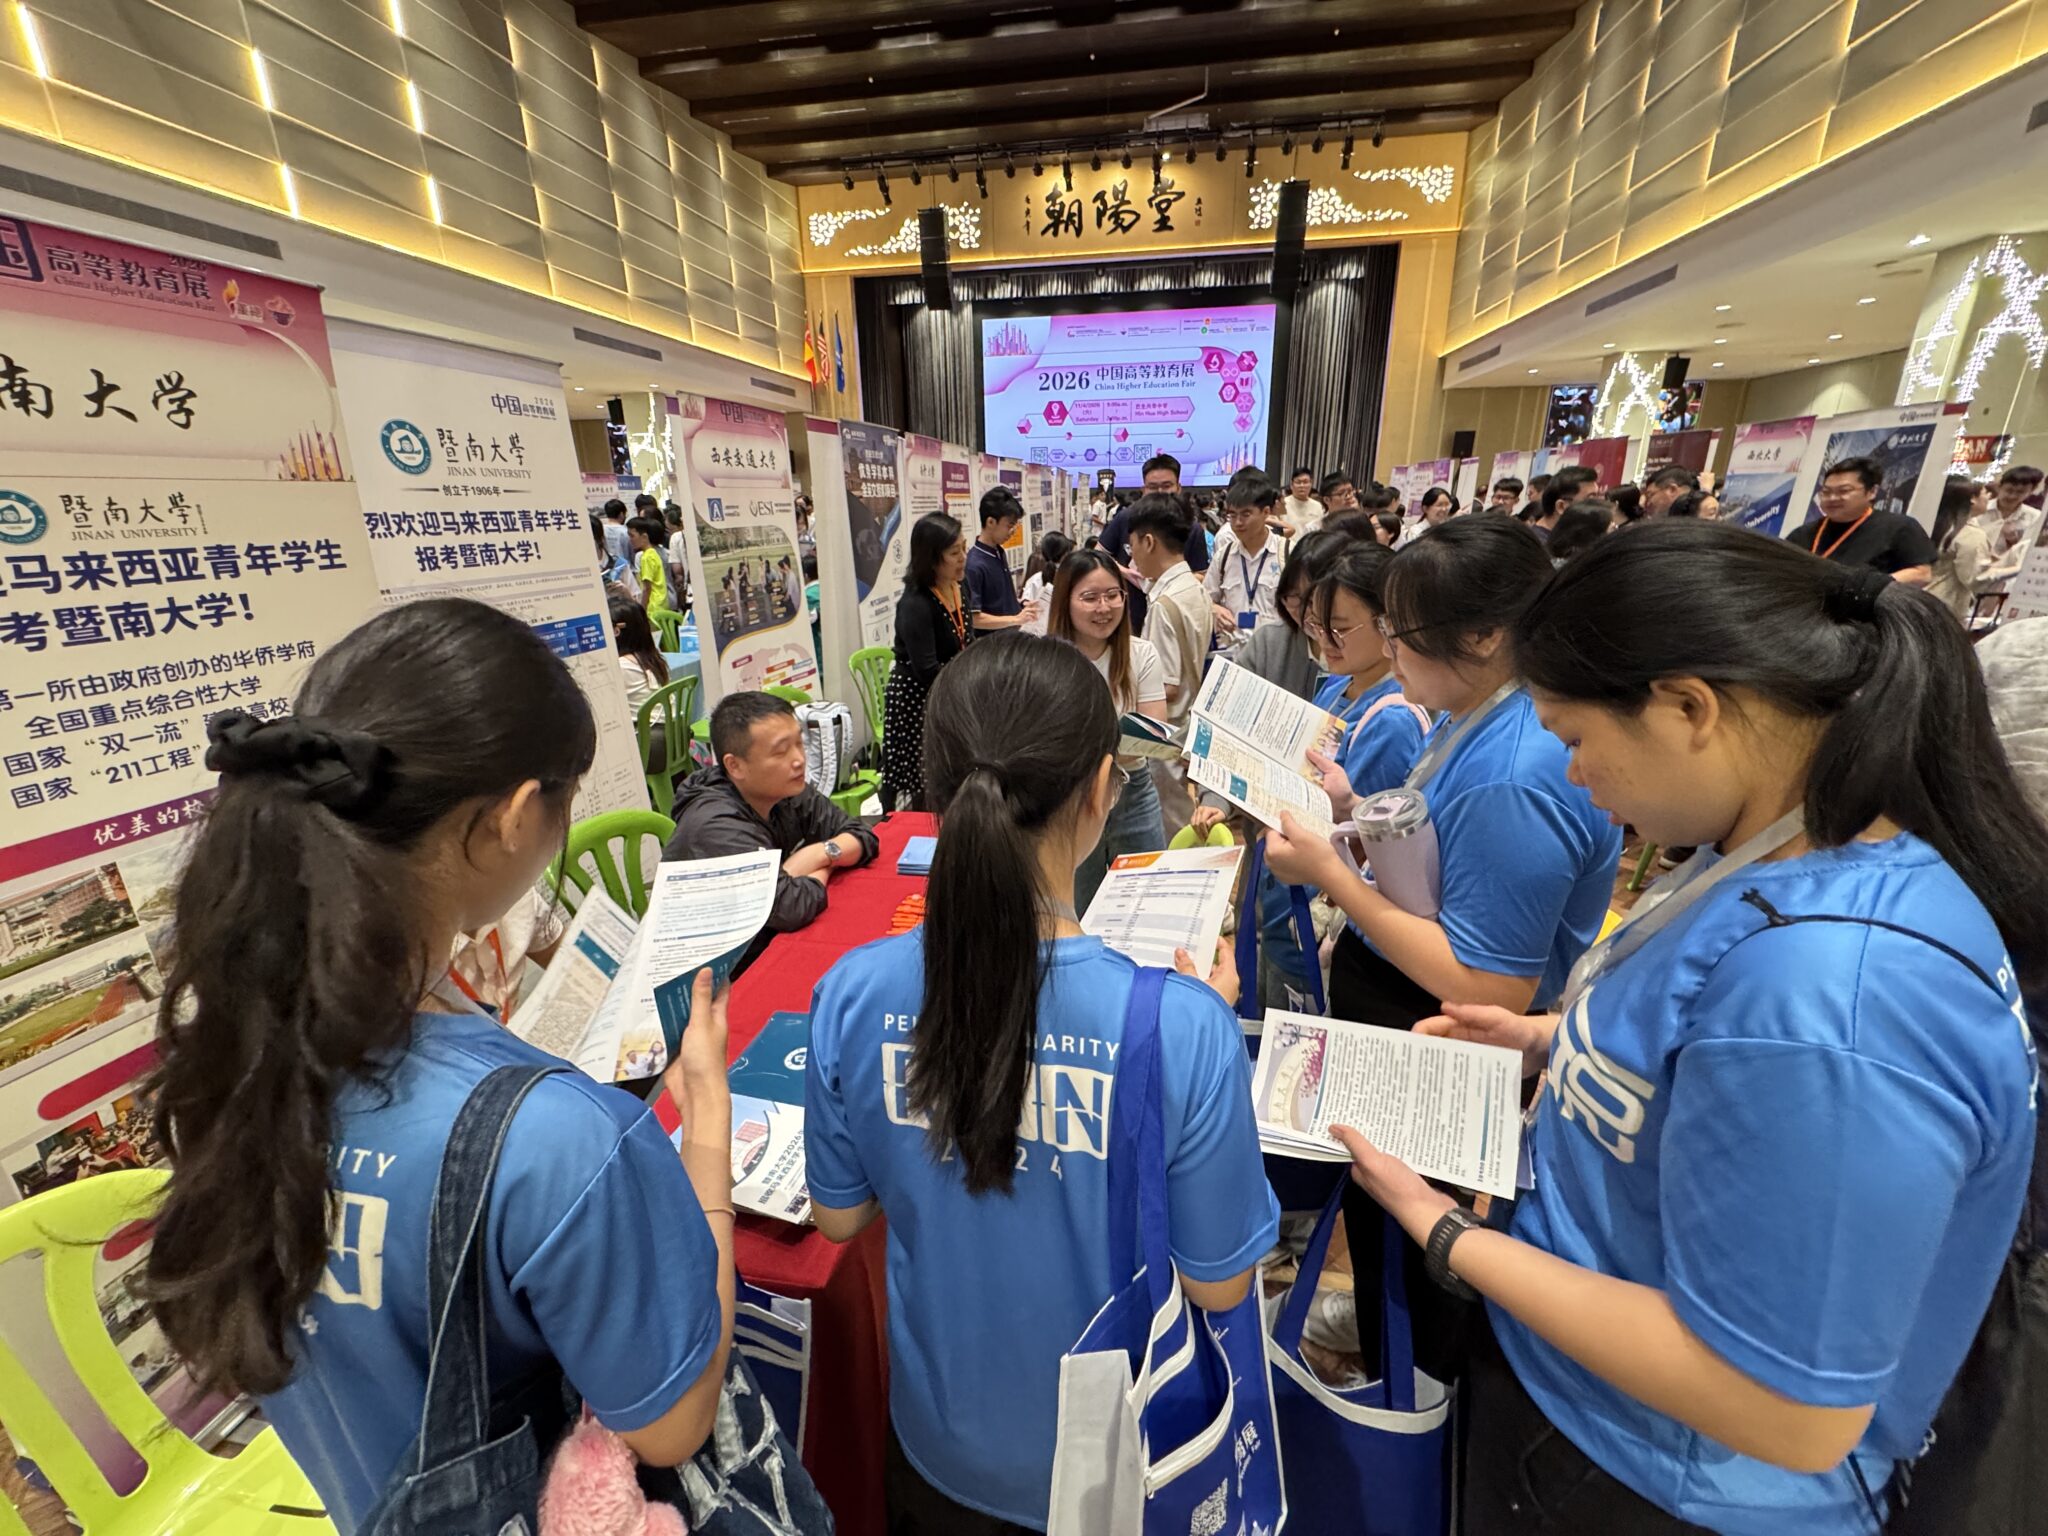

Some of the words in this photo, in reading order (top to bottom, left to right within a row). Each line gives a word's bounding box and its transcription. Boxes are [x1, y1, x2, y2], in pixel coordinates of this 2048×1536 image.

[45, 245, 211, 300] 高等教育展
[1038, 371, 1090, 391] 2026
[1094, 383, 1115, 391] China
[1117, 382, 1141, 391] Higher
[1143, 380, 1180, 389] Education
[1181, 380, 1196, 388] Fair
[1096, 363, 1195, 381] 中国高等教育展
[0, 354, 198, 429] 南大学
[447, 466, 477, 477] JINAN
[480, 467, 532, 480] UNIVERSITY
[442, 484, 502, 497] 创立于1906年
[71, 529, 115, 542] JINAN
[121, 527, 198, 540] UNIVERSITY
[363, 509, 582, 539] 烈欢迎马来西亚青年学生
[0, 538, 347, 597] 马来西亚青年学生
[415, 541, 542, 572] 报考暨南大学!
[24, 675, 262, 740] 全国重点综合性大学
[3, 697, 290, 777] 国家“双一流”高校
[941, 1136, 1064, 1182] 224
